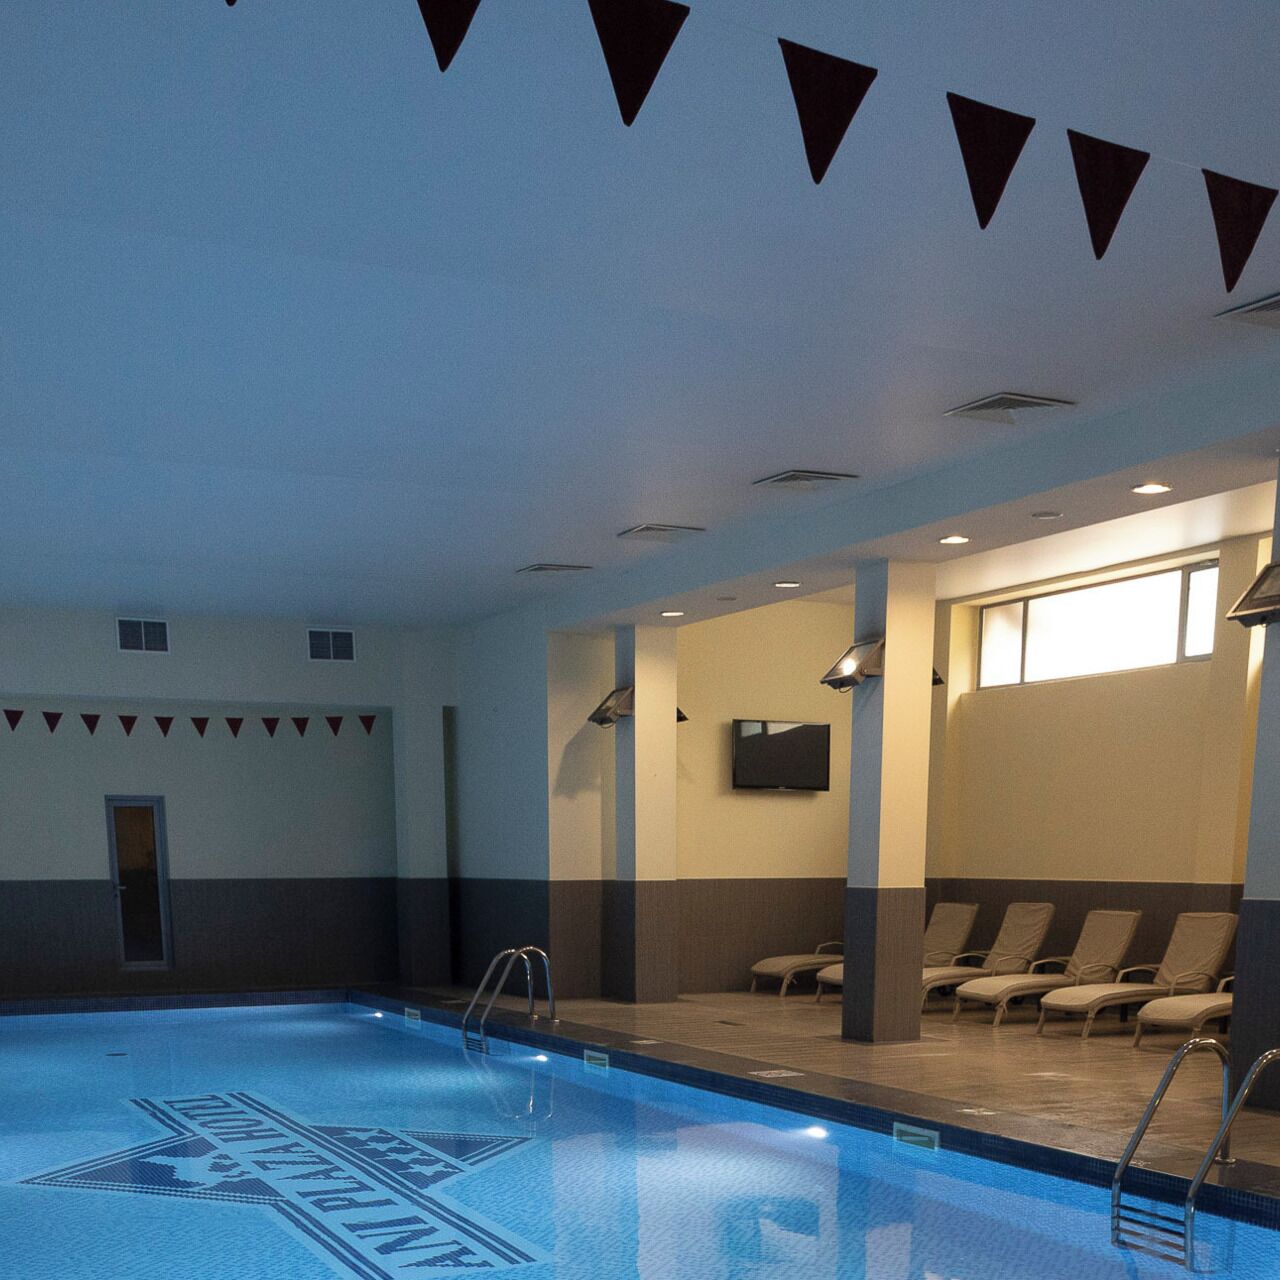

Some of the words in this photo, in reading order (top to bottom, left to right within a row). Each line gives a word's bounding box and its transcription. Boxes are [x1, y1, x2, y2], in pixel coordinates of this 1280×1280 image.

[163, 1094, 290, 1143] HOTEL
[240, 1141, 400, 1213] PLAZA
[340, 1214, 496, 1269] ANI
